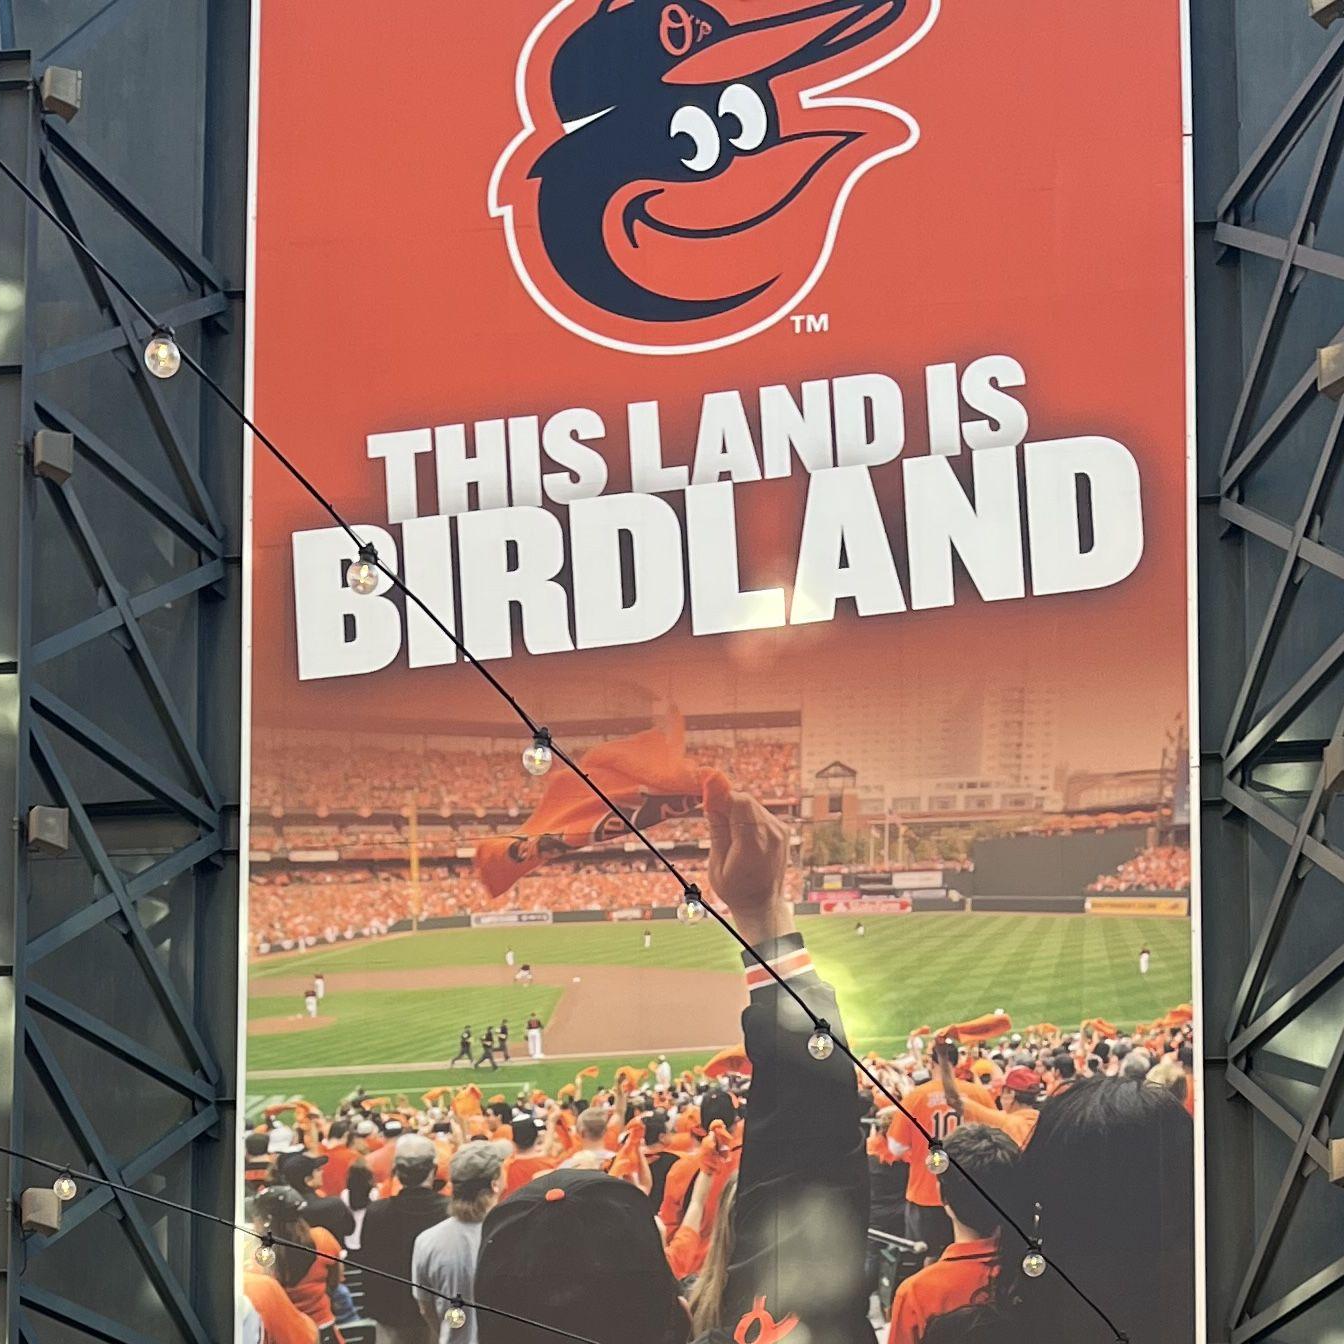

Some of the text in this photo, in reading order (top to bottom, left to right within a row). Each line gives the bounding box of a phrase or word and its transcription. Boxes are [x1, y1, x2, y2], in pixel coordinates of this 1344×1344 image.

[791, 315, 830, 333] TM
[367, 354, 1029, 524] THIS LAND IS
[291, 435, 1144, 681] BIRDLAND
